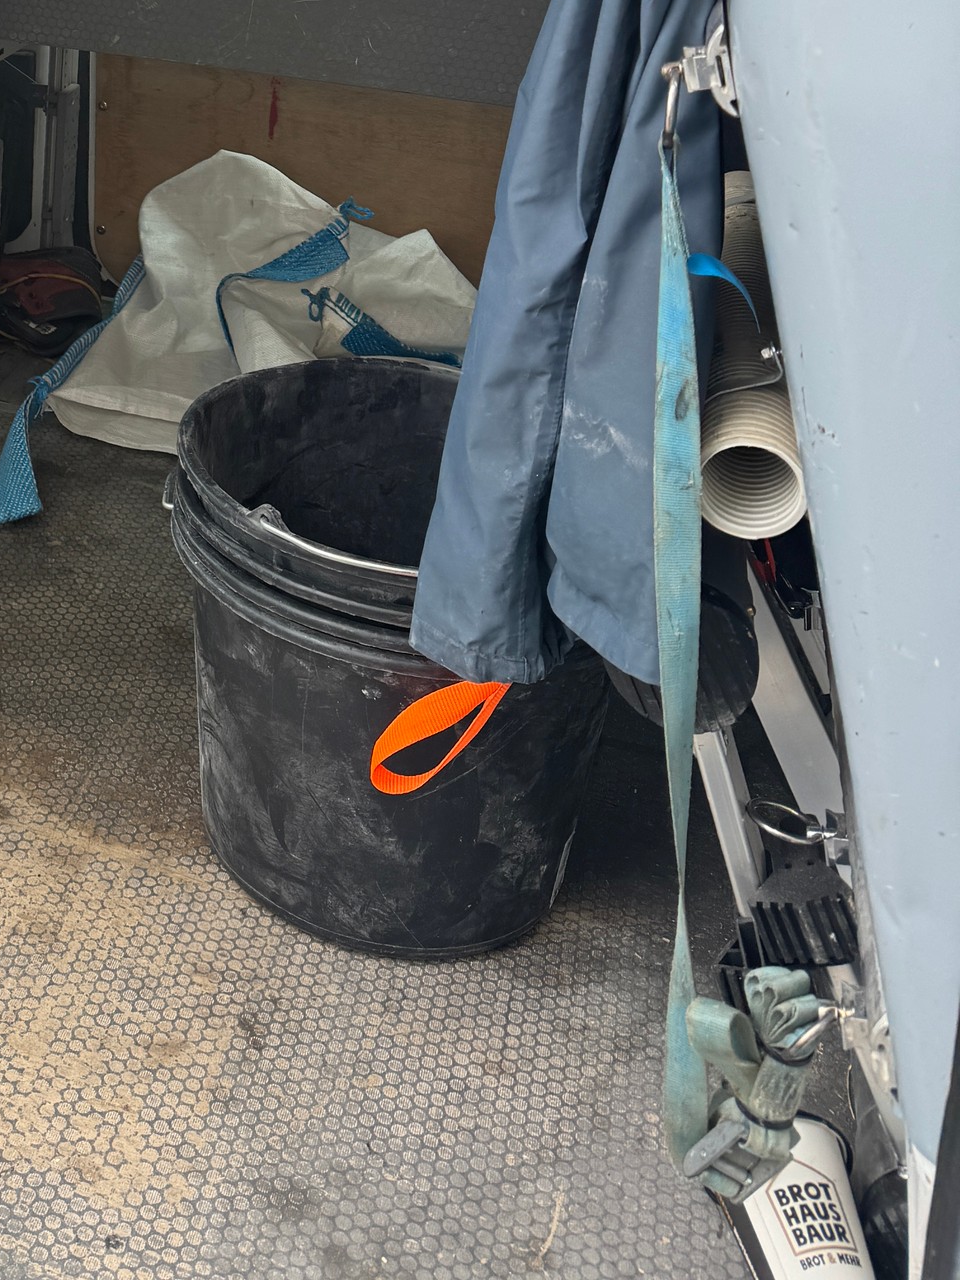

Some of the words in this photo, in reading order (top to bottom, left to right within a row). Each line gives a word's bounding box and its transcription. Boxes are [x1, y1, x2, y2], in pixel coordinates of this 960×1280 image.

[774, 1182, 832, 1207] BROT
[782, 1202, 841, 1227] HAUS
[791, 1222, 850, 1247] BAUR
[800, 1254, 826, 1271] BROT
[827, 1252, 836, 1264] &
[836, 1252, 862, 1269] MEHR
